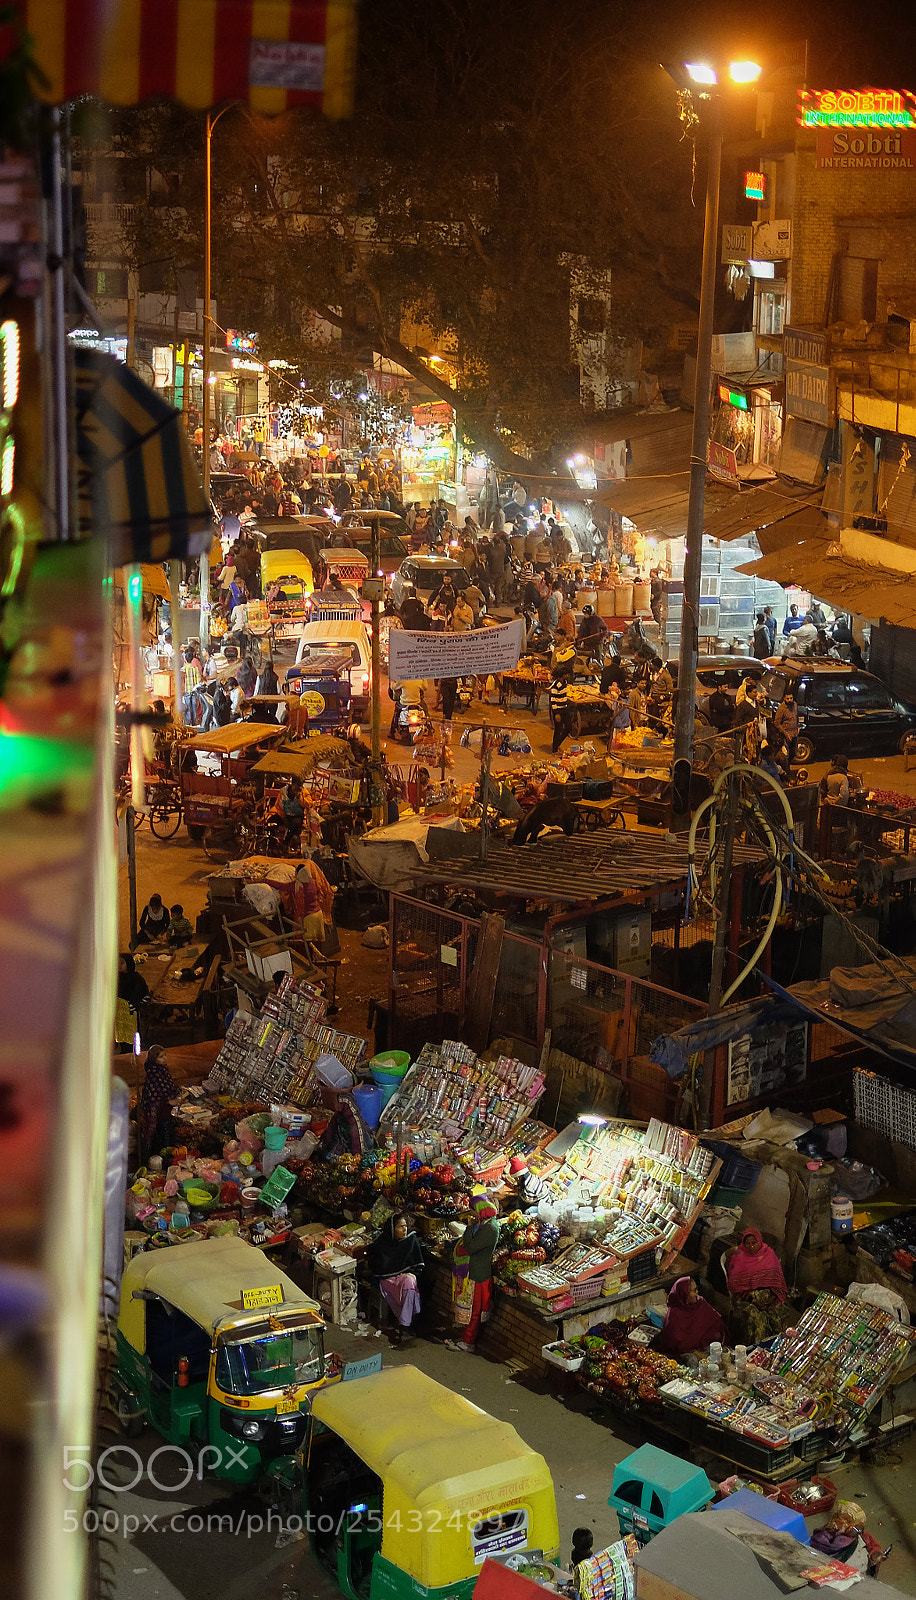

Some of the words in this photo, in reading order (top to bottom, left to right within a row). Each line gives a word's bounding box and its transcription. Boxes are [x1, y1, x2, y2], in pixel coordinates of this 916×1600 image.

[820, 93, 902, 113] SOBTI
[804, 111, 913, 125] INTERNATIONAL
[833, 132, 902, 155] Sobti
[820, 157, 914, 168] INTERNATIONAL
[726, 228, 747, 251] Sobti
[783, 335, 796, 358] OM
[798, 338, 824, 363] DAIRY
[787, 371, 800, 398] OM
[802, 374, 828, 405] DAIRY
[346, 1366, 357, 1376] ON
[358, 1360, 379, 1374] DUTY
